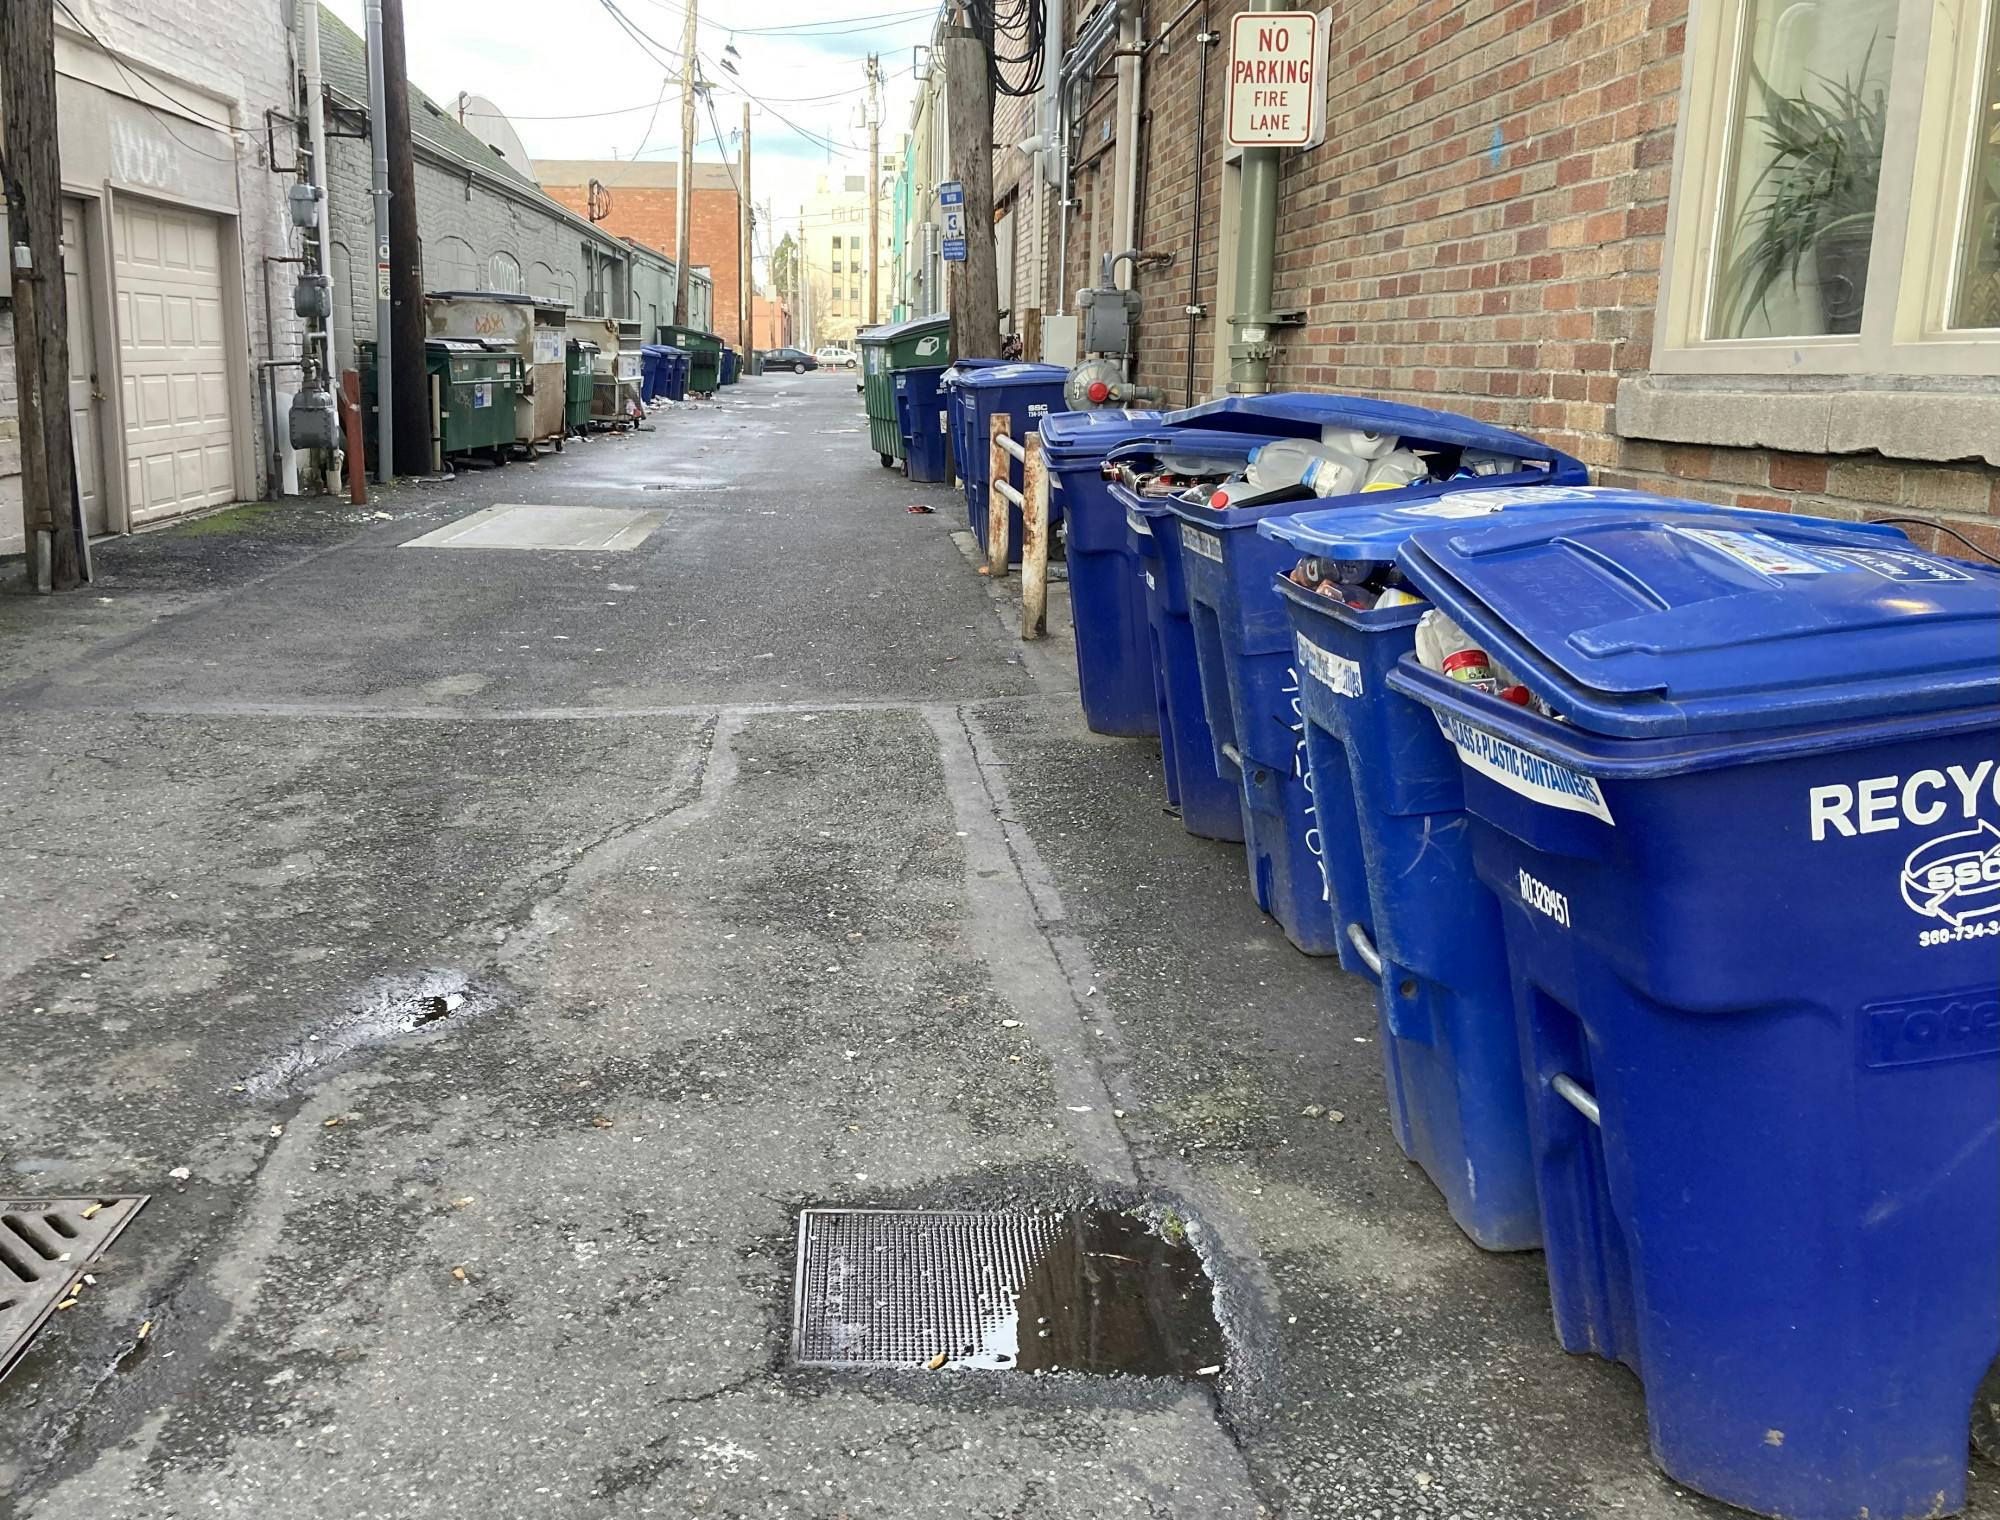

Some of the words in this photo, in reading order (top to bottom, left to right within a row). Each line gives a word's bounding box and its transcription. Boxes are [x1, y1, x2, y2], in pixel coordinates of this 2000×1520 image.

[1258, 28, 1289, 52] NO
[1235, 59, 1310, 84] PARKING
[1254, 90, 1289, 107] FIRE
[1250, 114, 1291, 130] LANE
[1476, 734, 1482, 756] &
[1481, 735, 1520, 777] PLASTIC
[1520, 752, 1600, 806] CONTAINERS
[1810, 760, 2000, 841] RECY
[1919, 920, 2000, 947] 360-734-3
